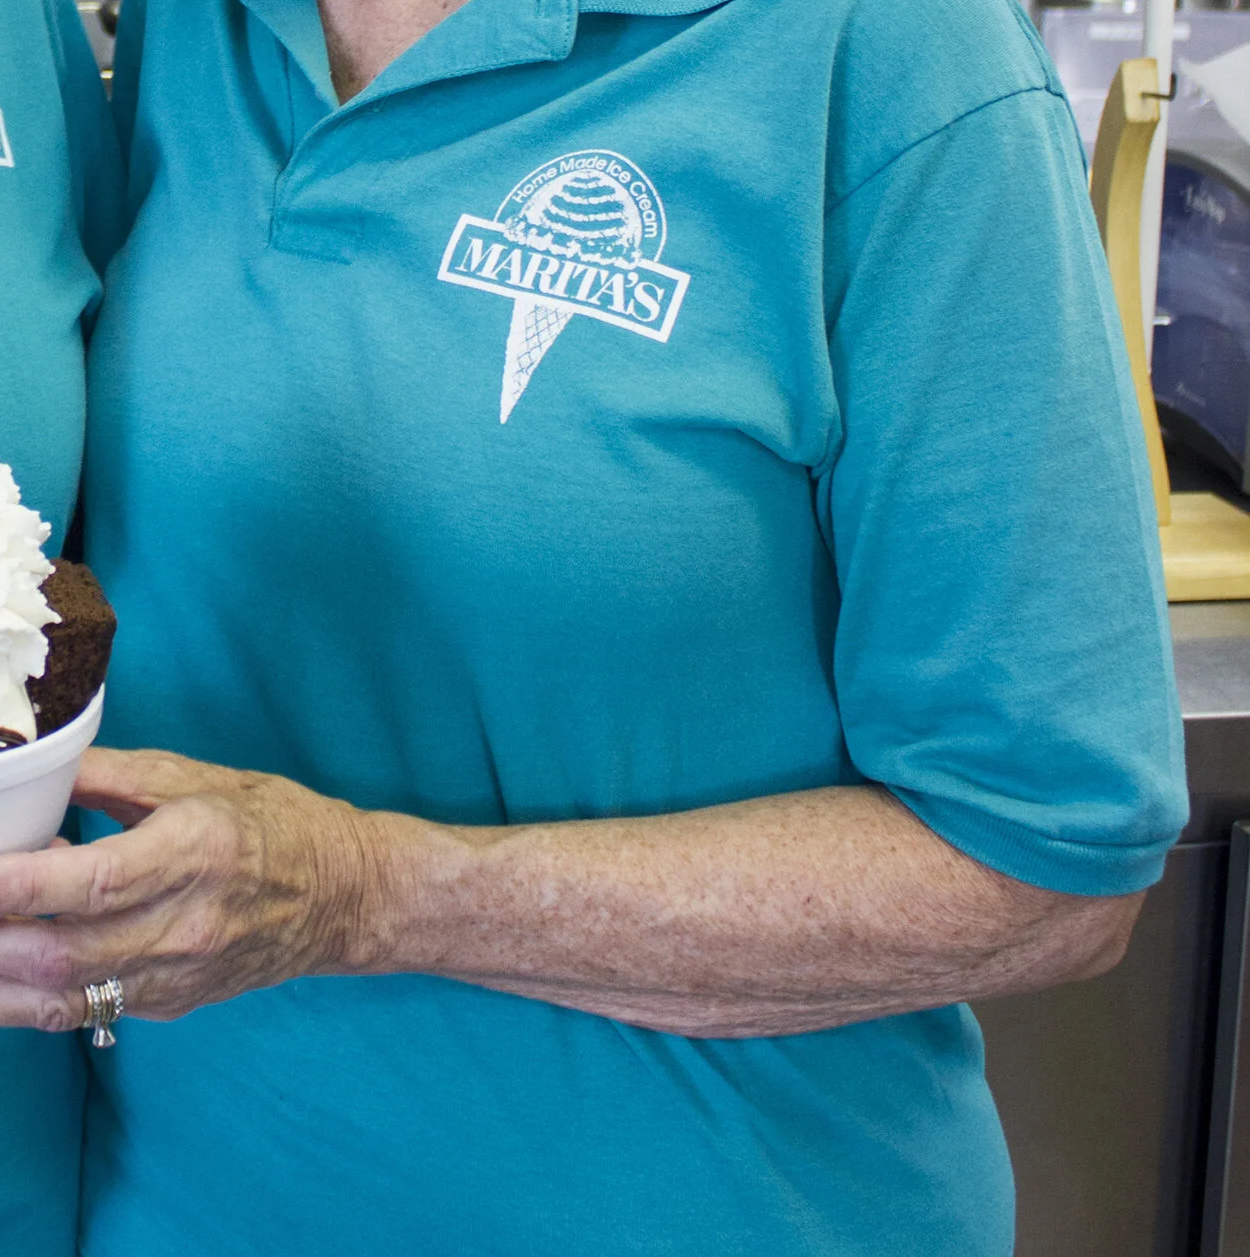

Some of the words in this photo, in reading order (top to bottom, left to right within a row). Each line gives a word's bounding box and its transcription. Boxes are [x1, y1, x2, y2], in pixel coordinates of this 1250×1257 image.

[511, 167, 558, 204] Home
[559, 155, 607, 174] Made
[607, 159, 631, 182] Ice
[629, 180, 657, 239] Cream
[454, 236, 665, 322] MARITA'S
